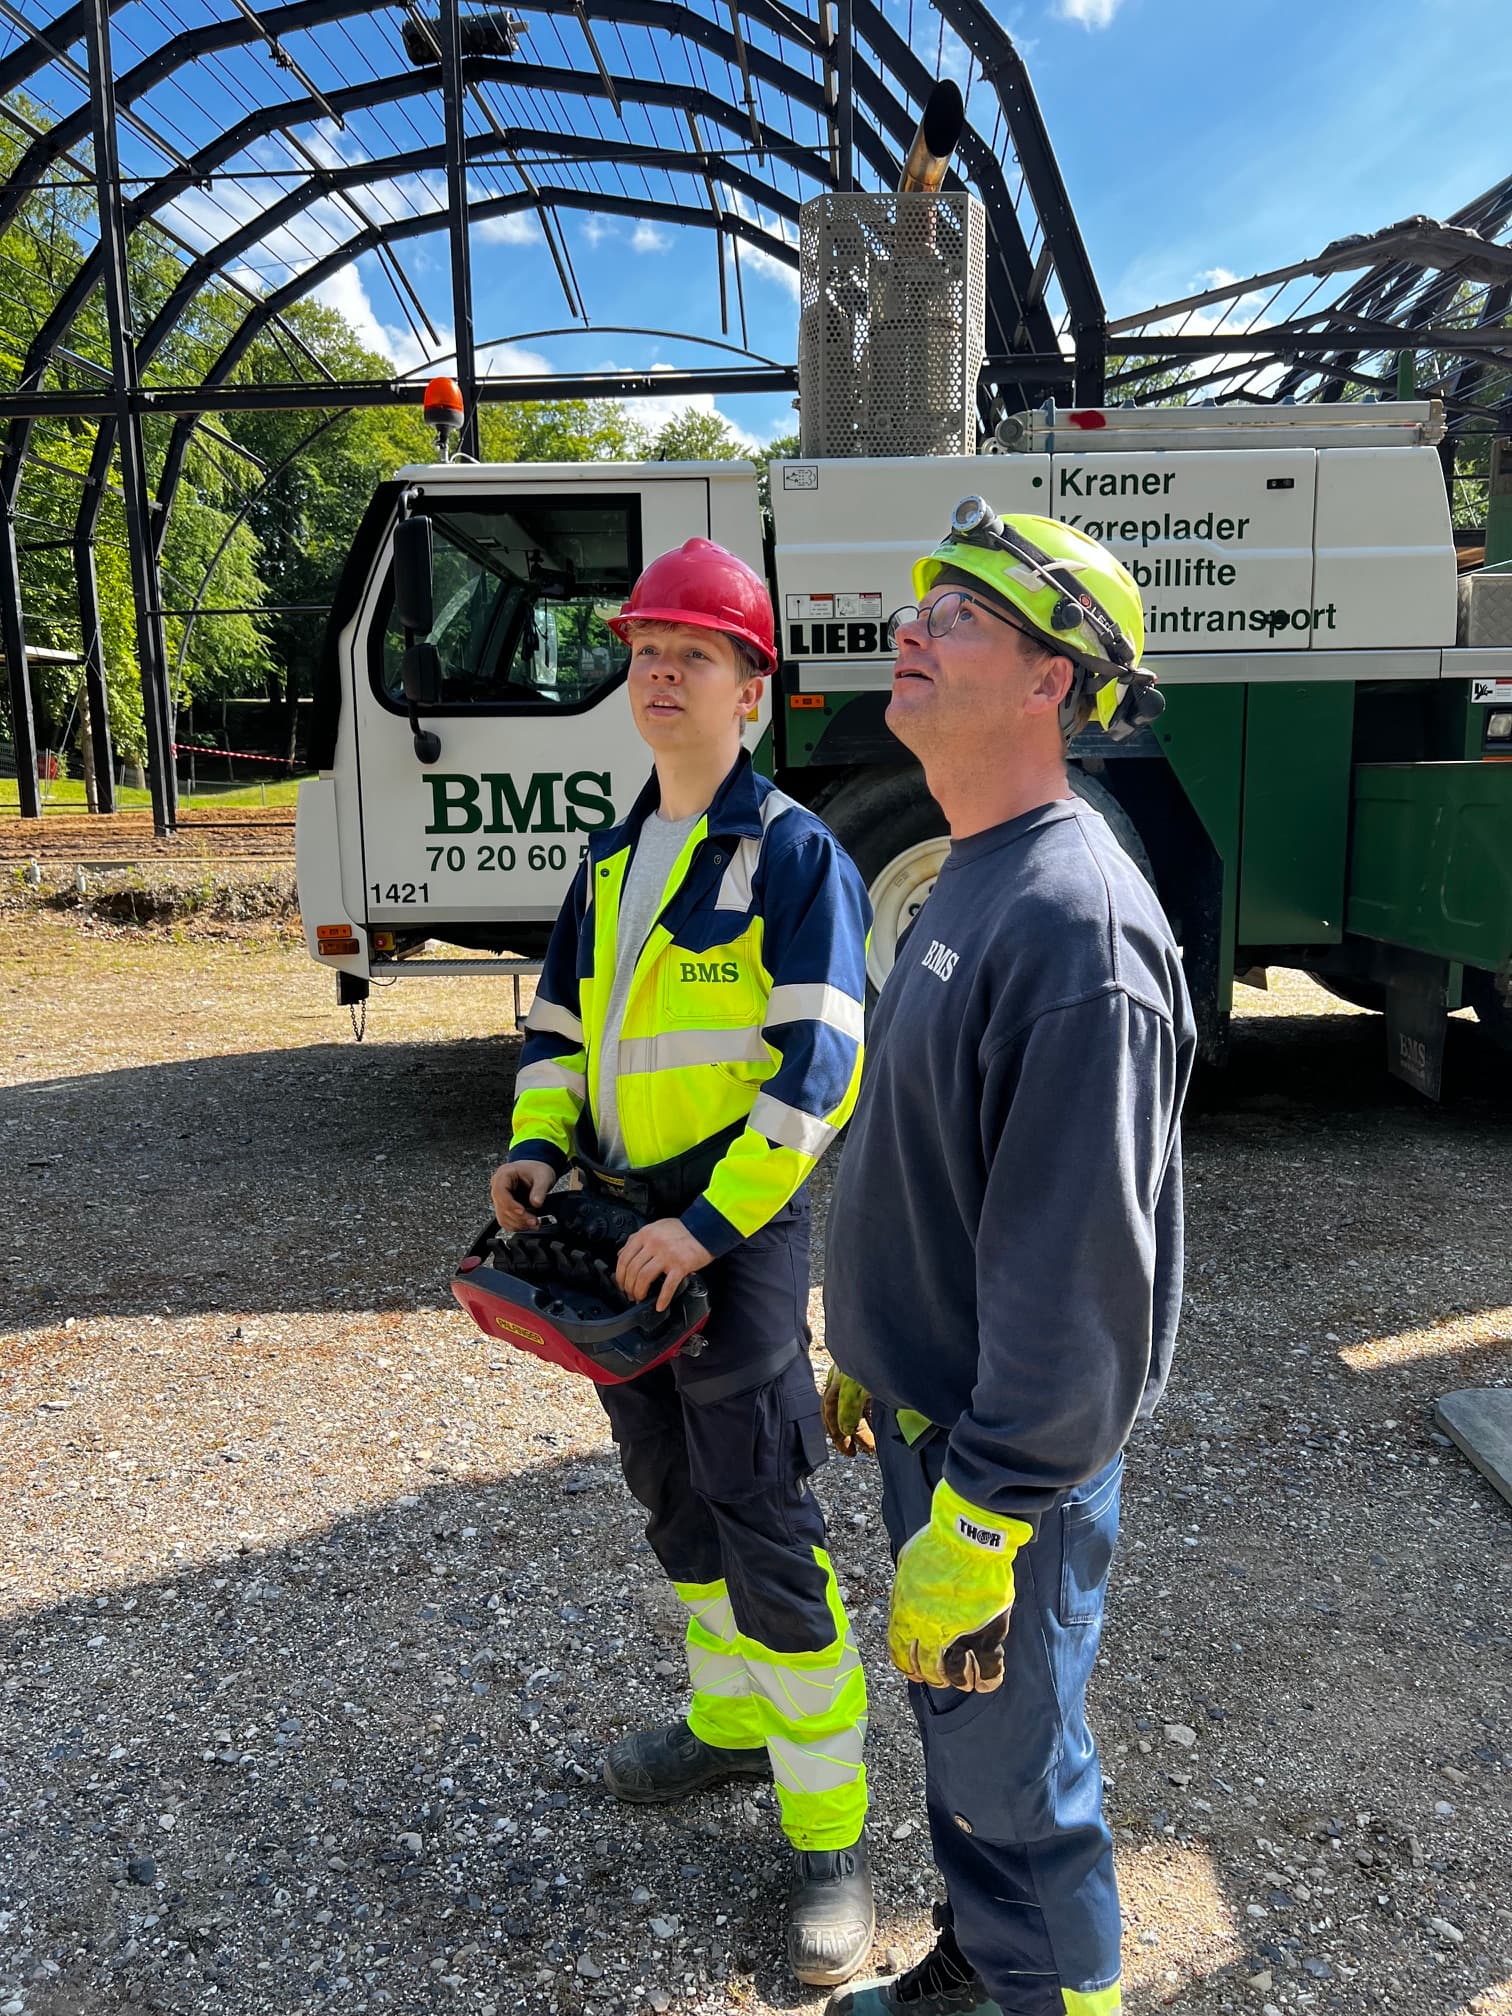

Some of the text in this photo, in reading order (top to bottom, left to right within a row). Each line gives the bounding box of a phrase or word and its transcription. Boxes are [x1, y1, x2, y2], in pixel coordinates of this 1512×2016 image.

[1060, 468, 1176, 497] Kraner
[422, 770, 617, 835] BMS
[425, 845, 467, 872] 70
[477, 845, 517, 872] 20
[527, 844, 567, 871] 60
[371, 882, 430, 904] 1421
[680, 962, 740, 983] BMS
[920, 939, 960, 983] BMS
